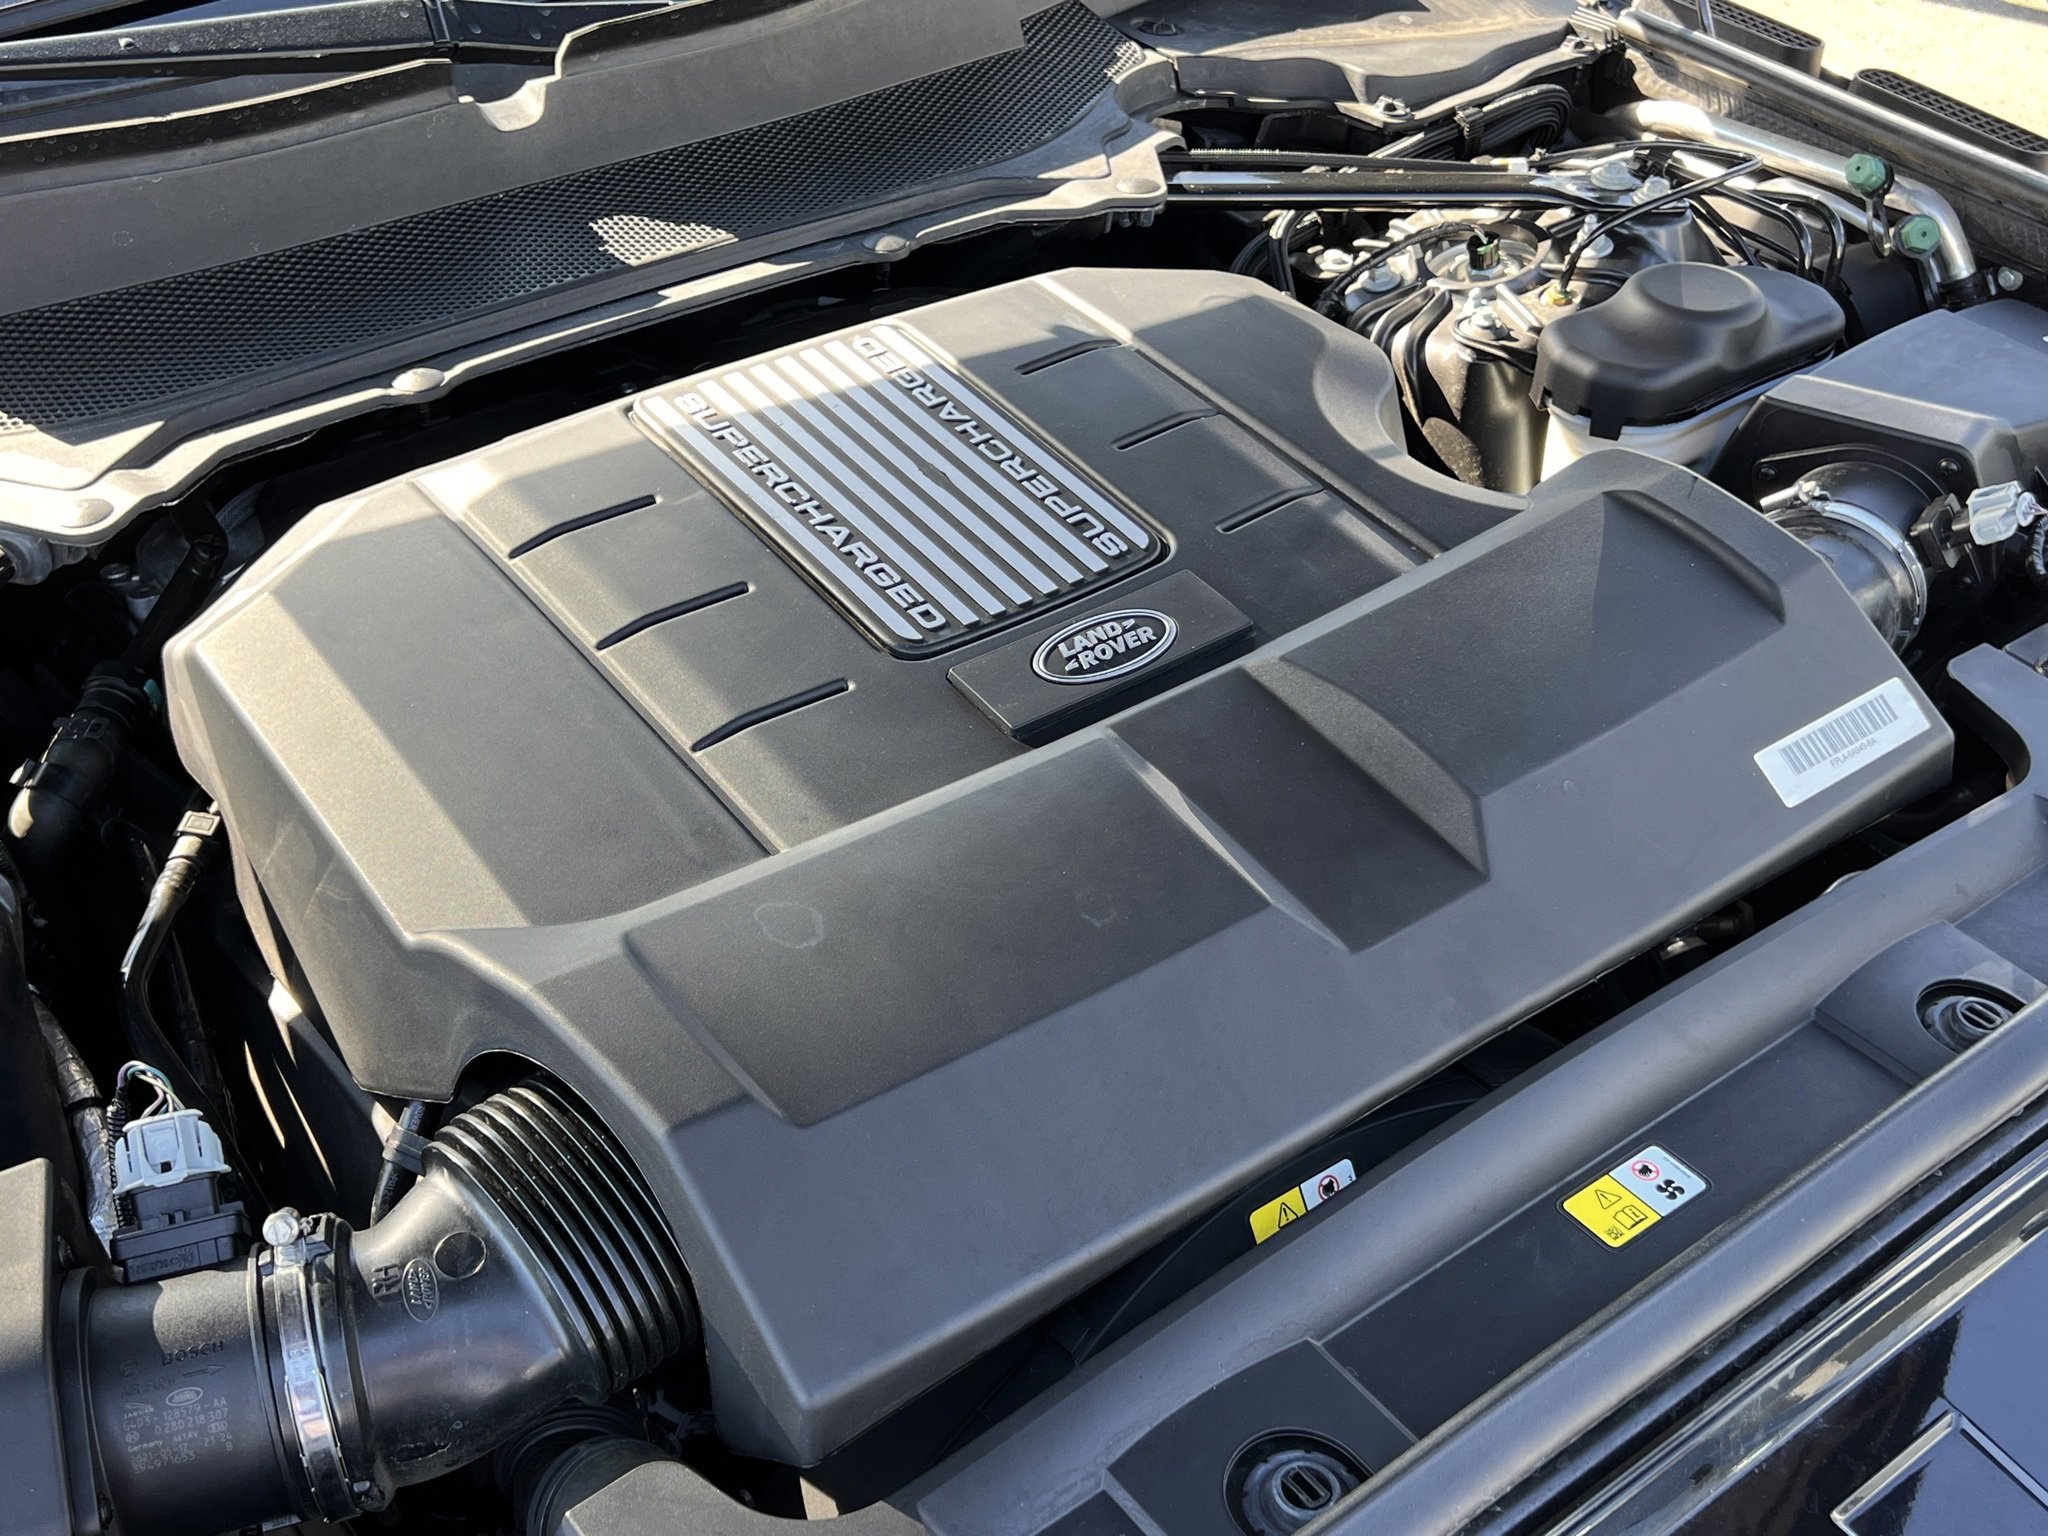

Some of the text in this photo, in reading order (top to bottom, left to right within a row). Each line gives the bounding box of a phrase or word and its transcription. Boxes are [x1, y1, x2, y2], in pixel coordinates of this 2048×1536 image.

[852, 336, 1128, 556] SUPERCHARGED
[674, 392, 947, 630] SUPERCHARGED
[1058, 621, 1122, 659] LAND
[1077, 626, 1157, 670] ROVER
[371, 1263, 400, 1297] RH
[162, 1340, 225, 1366] BOSCH
[124, 1407, 154, 1419] JAGUAR
[128, 1440, 163, 1452] Germany
